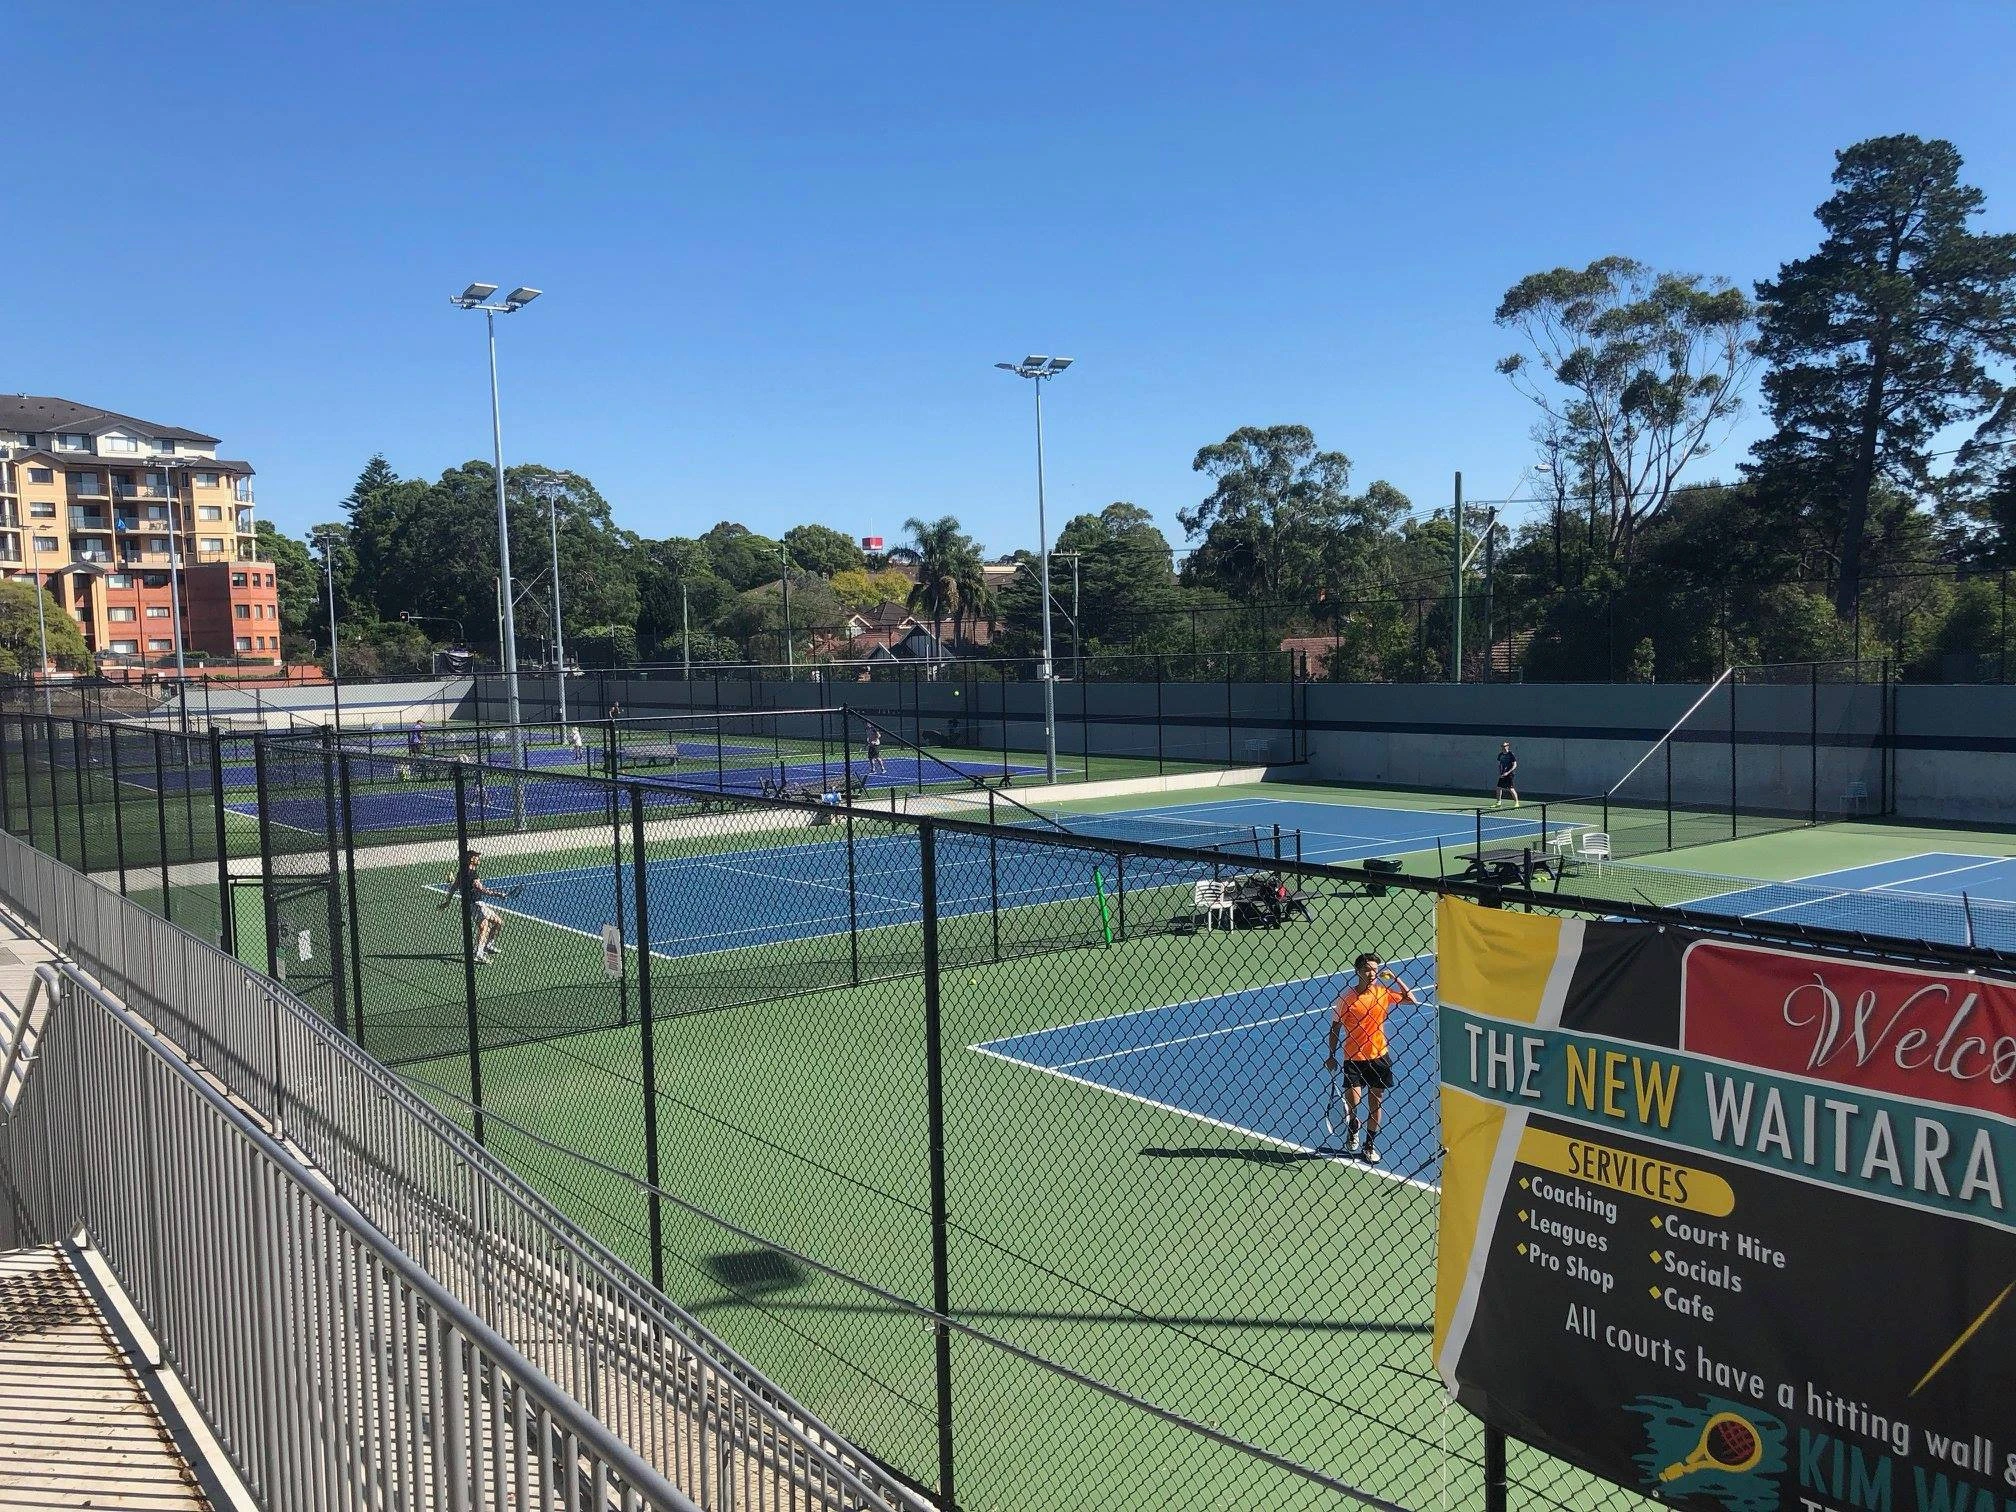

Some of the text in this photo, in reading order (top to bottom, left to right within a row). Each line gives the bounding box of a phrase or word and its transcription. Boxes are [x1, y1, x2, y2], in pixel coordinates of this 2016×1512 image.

[1784, 973, 2016, 1084] Welco
[1464, 1022, 2003, 1210] THE NEW WAITARA
[1568, 1141, 1688, 1204] SERVICES
[1531, 1176, 1618, 1225] Coaching
[1530, 1209, 1608, 1252] Leagues
[1664, 1214, 1786, 1269] Court Hire
[1529, 1242, 1615, 1293] Pro Shop
[1664, 1250, 1743, 1293] Socials
[1663, 1287, 1715, 1322] Cafe
[1565, 1302, 1596, 1340] All
[1605, 1324, 1686, 1372] courts
[1697, 1346, 1765, 1399] have
[1776, 1383, 1794, 1410] a
[1806, 1381, 1910, 1456] hitting
[1923, 1428, 1993, 1476] wall
[1799, 1427, 1893, 1512] KIM
